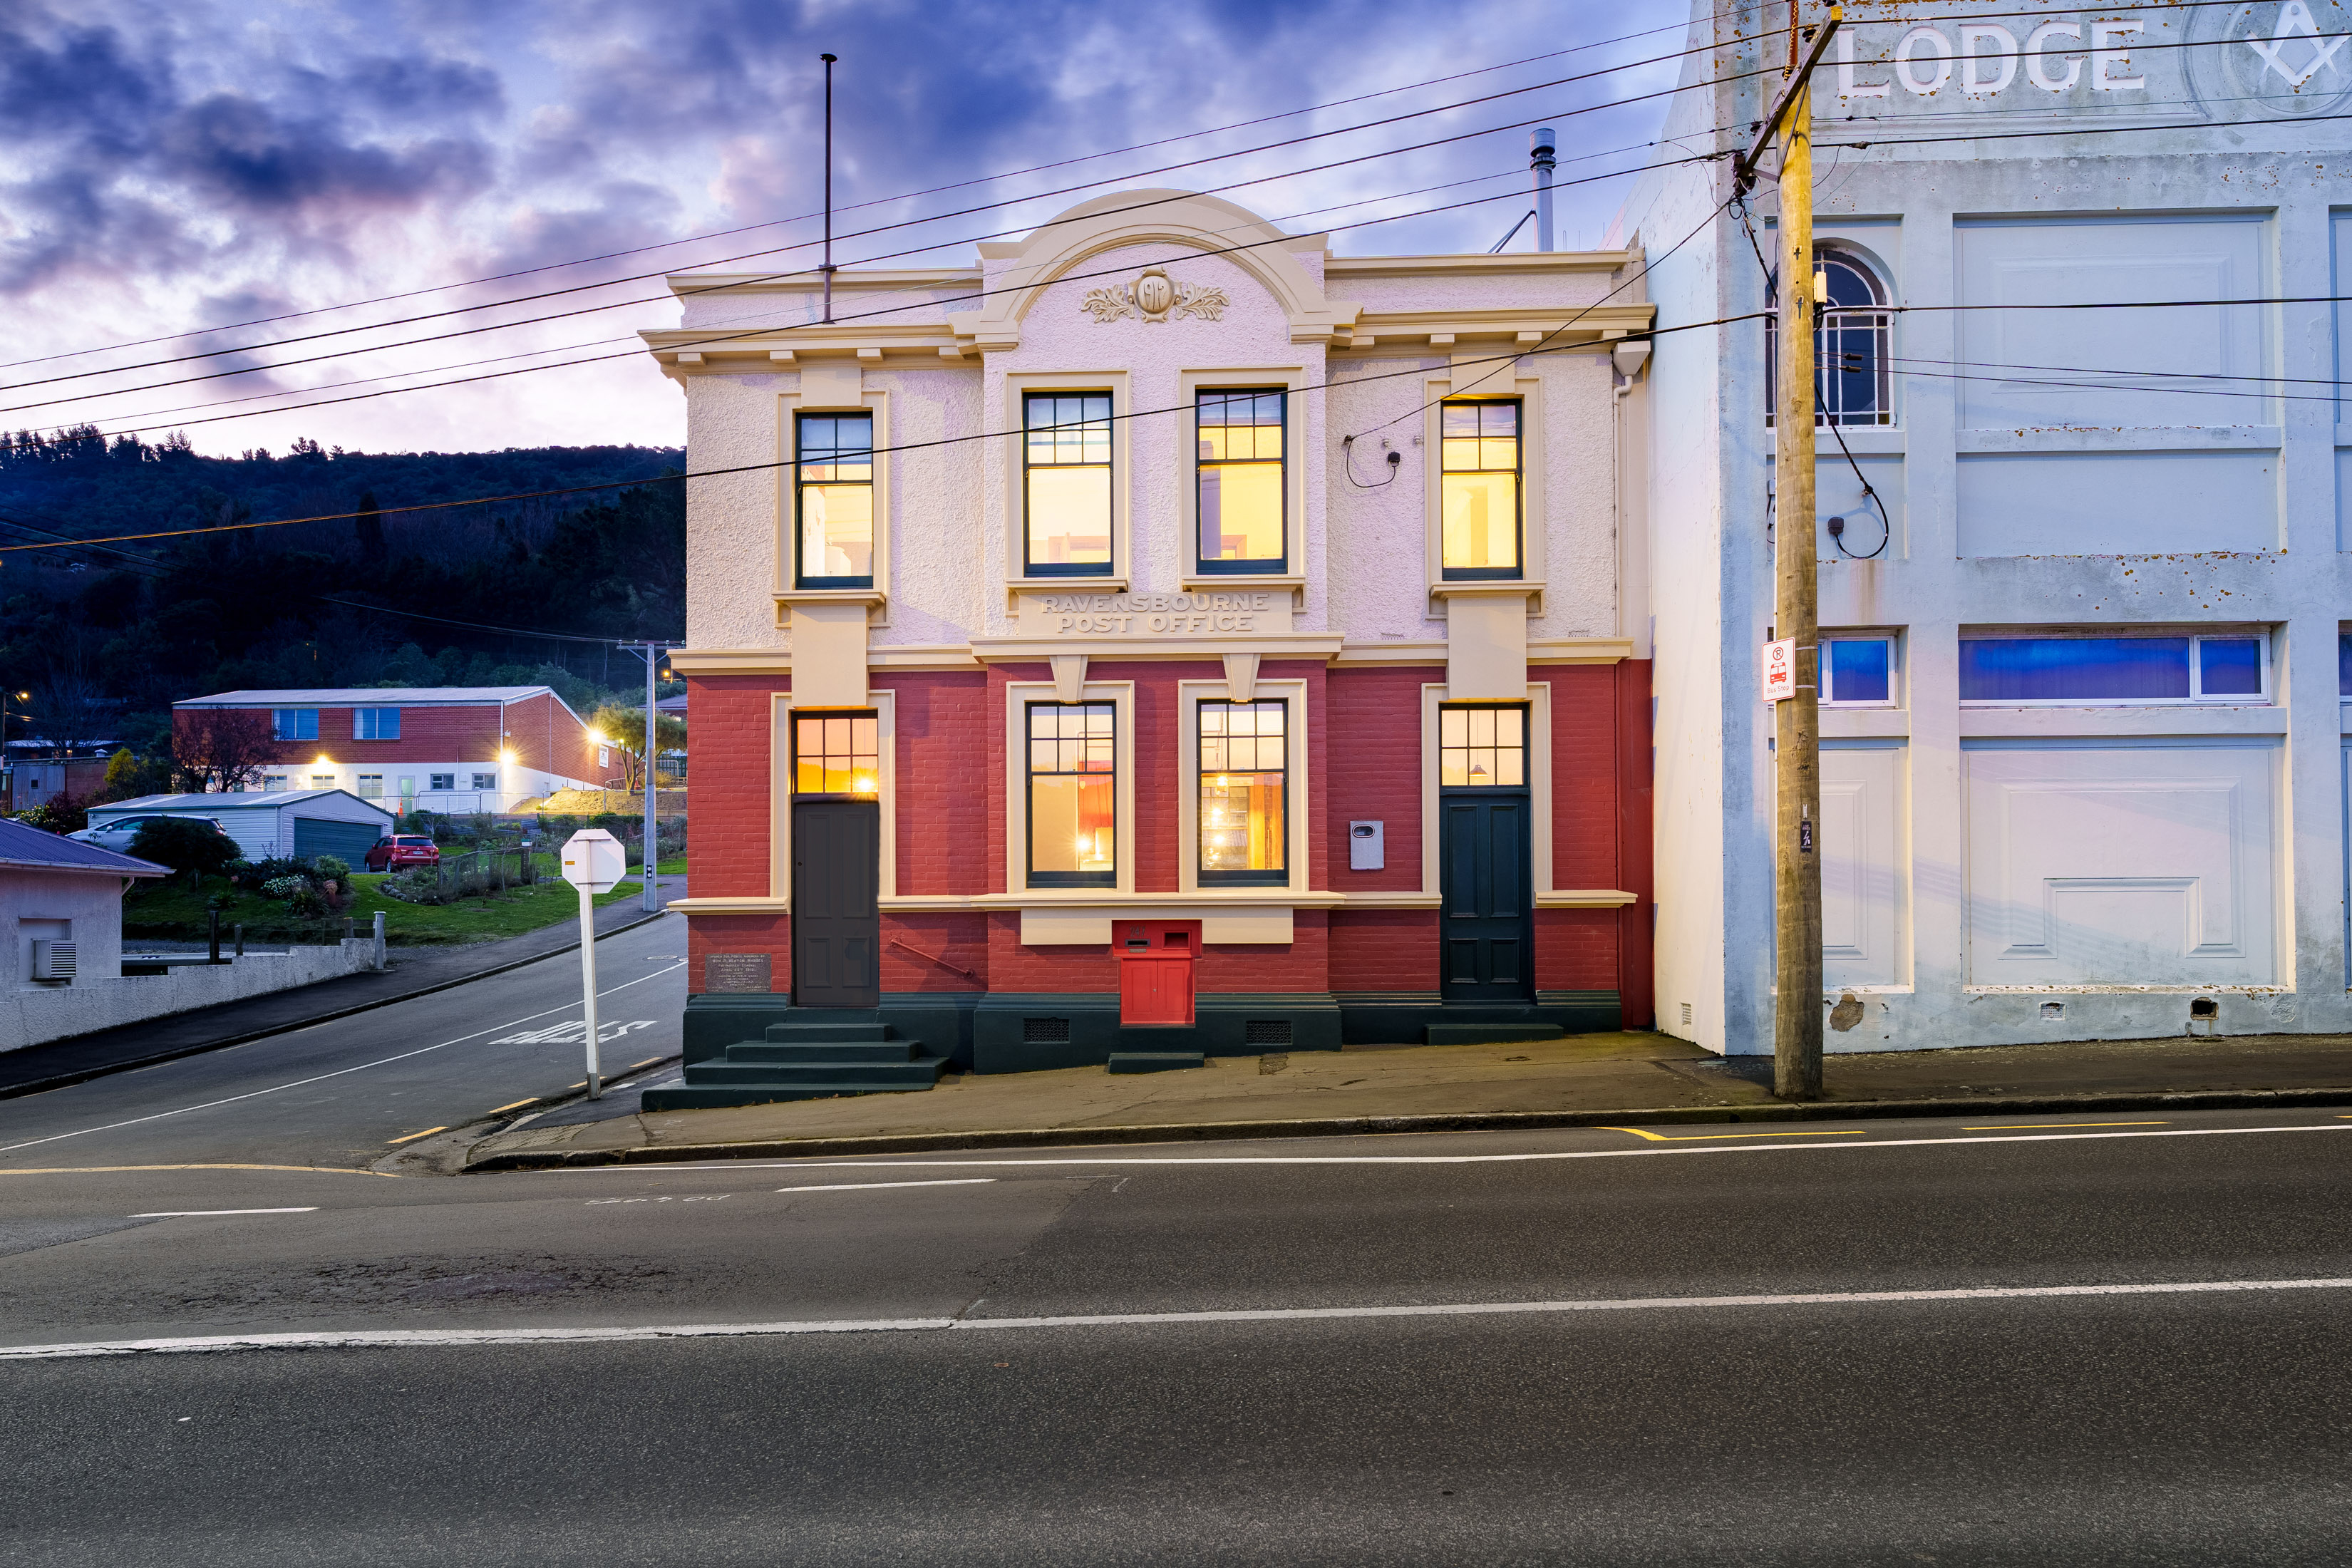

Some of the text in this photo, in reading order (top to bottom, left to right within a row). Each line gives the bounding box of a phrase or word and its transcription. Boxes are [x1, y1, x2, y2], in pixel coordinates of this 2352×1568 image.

[1835, 20, 2145, 98] LODGE
[1041, 593, 1269, 613] RAVENSBOURNE
[1056, 614, 1254, 634] POST OFFICE
[1129, 926, 1145, 937] 247
[487, 1021, 659, 1045] STOP
